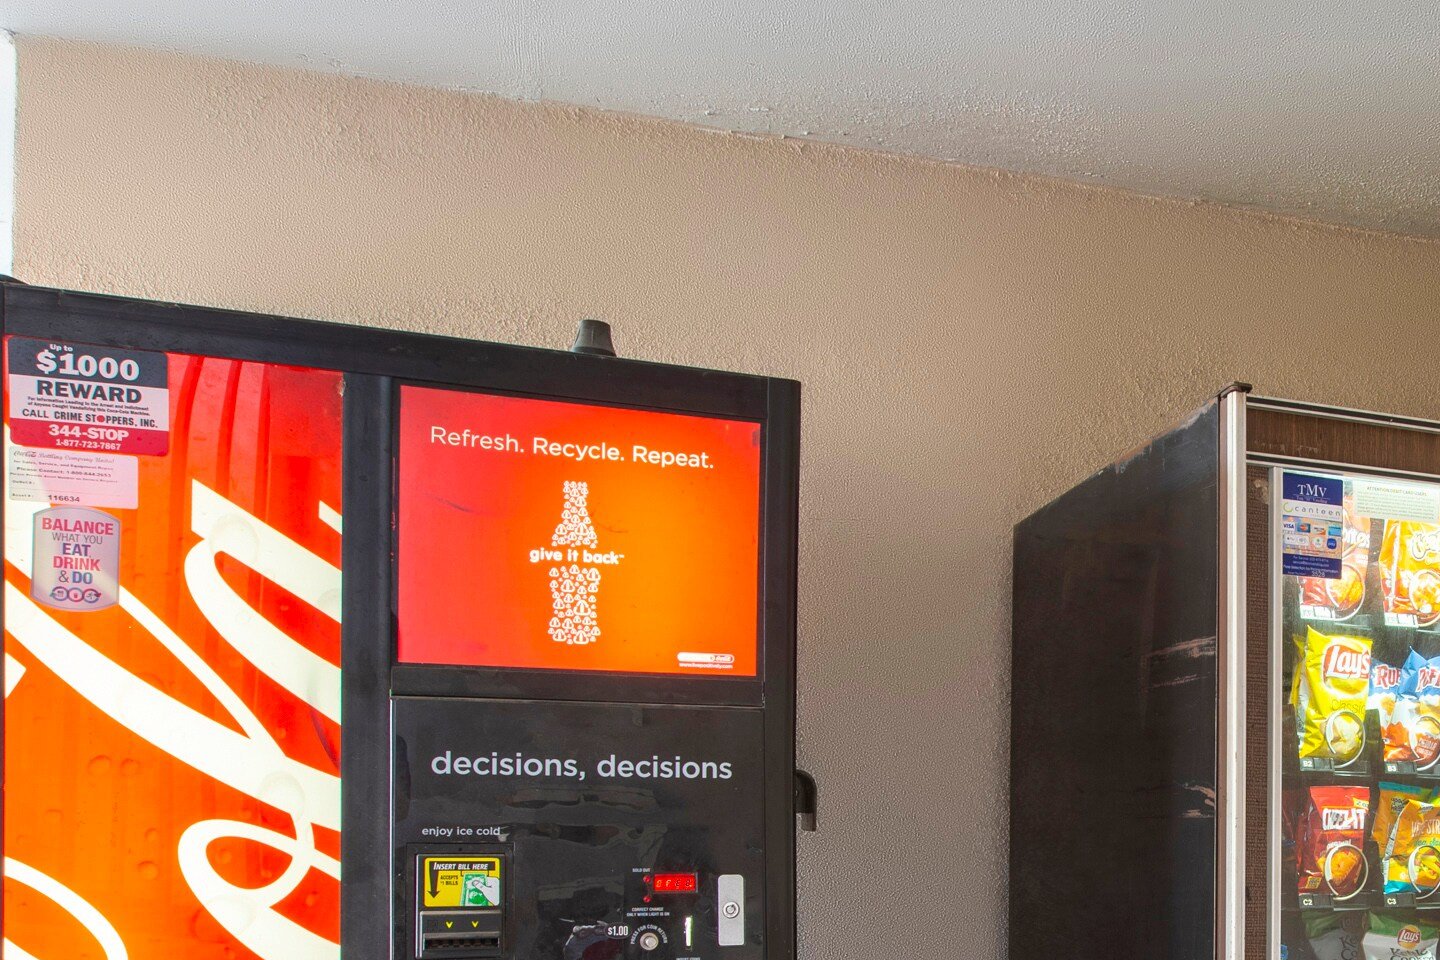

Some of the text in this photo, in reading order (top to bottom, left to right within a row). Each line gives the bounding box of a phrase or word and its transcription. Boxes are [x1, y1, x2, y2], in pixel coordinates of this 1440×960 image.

[50, 343, 73, 352] Up to
[36, 349, 140, 381] $1000
[36, 379, 142, 404] REWARD
[22, 409, 49, 419] CALL
[54, 411, 83, 422] CRIME
[140, 418, 158, 428] INC.
[48, 424, 129, 442] 344-STOP
[56, 438, 121, 450] 1-877-723-7867
[431, 426, 715, 470] Refresh. Recycle. Repeat.
[1297, 483, 1328, 498] TMV
[48, 494, 80, 502] 116634
[1294, 506, 1341, 517] canteen
[41, 517, 114, 536] BALANCE
[52, 532, 103, 545] WHAT YOU
[62, 543, 92, 557] EAT
[529, 547, 563, 564] give
[566, 547, 579, 562] it
[52, 555, 101, 572] DRINK
[58, 571, 94, 585] & DO
[1327, 645, 1371, 679] Lay's
[431, 751, 733, 782] decisions, decisions
[421, 826, 501, 837] enjoy ice cold
[433, 862, 457, 871] INSERT
[1303, 898, 1313, 906] C2
[1387, 897, 1397, 905] C3
[607, 925, 629, 936] $1.00
[638, 925, 647, 933] FOR
[657, 926, 668, 944] RETURN
